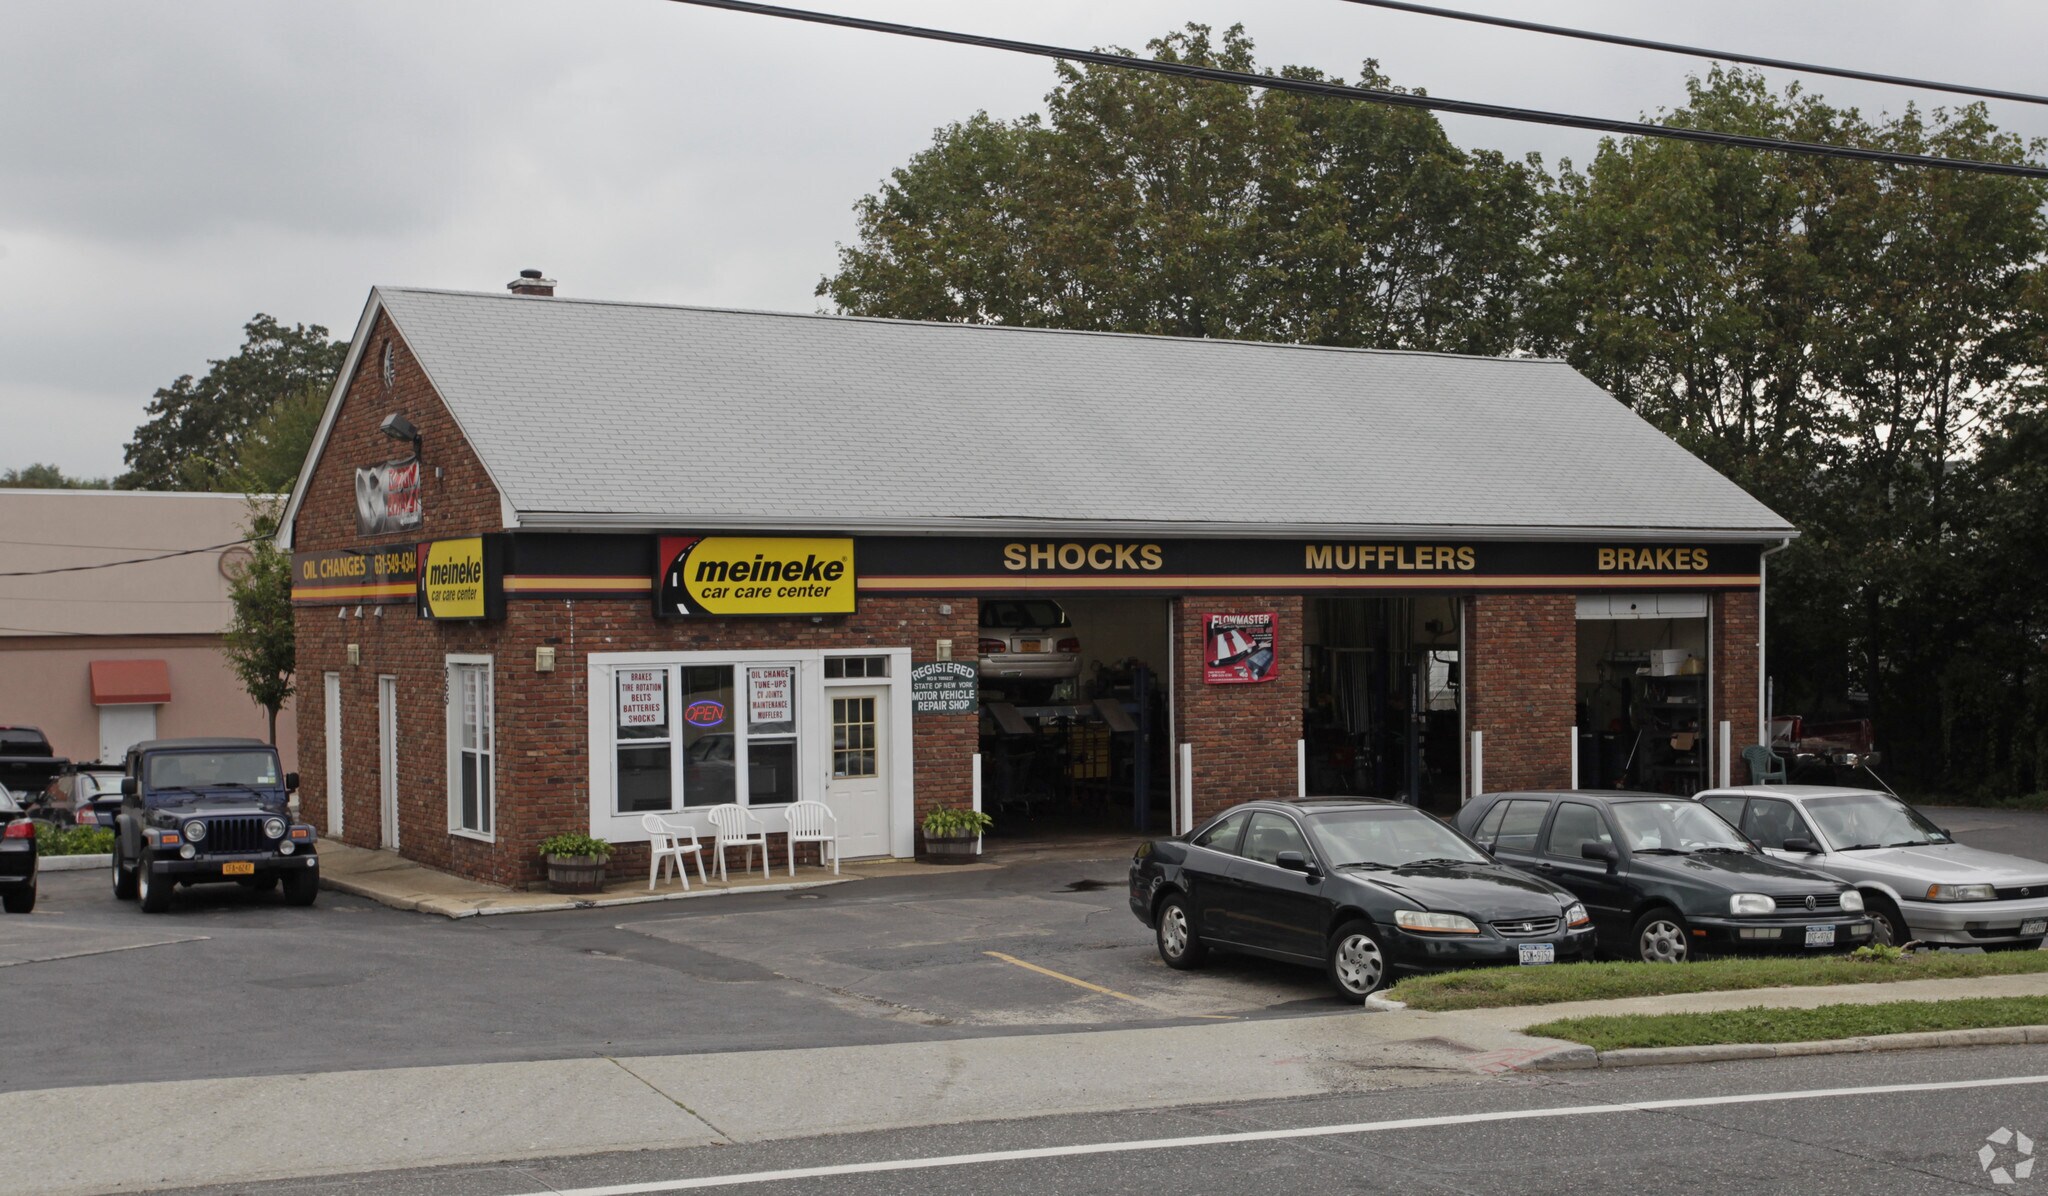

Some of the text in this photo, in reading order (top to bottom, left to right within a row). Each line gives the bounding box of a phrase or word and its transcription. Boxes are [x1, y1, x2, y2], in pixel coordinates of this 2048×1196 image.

[1003, 543, 1163, 571] SHOCKS
[1305, 545, 1476, 571] MUFFLERS
[1598, 548, 1709, 571] BRAKES
[303, 560, 318, 579] OIL
[320, 555, 366, 579] CHANGES
[430, 556, 481, 585] meineke
[695, 554, 845, 582] meineke
[431, 587, 477, 602] car care center
[701, 584, 832, 599] car care center
[1211, 614, 1270, 629] FLOWMASTER
[631, 673, 652, 681] BRAKES
[751, 670, 789, 679] OIL CHANGE
[911, 662, 974, 681] REGISTERED
[622, 683, 661, 692] TIRE ROTATION
[754, 680, 787, 689] TUNE-UPS
[631, 694, 651, 702] BELTS
[912, 690, 974, 701] MOTOR VEHICLE
[623, 704, 660, 713] BATTERIES
[752, 701, 787, 709] MAINTENANCE
[918, 700, 969, 711] REPAIR SHOP
[628, 714, 656, 723] SHOCKS
[685, 705, 725, 721] OPEN
[758, 711, 783, 719] MUFFLERS
